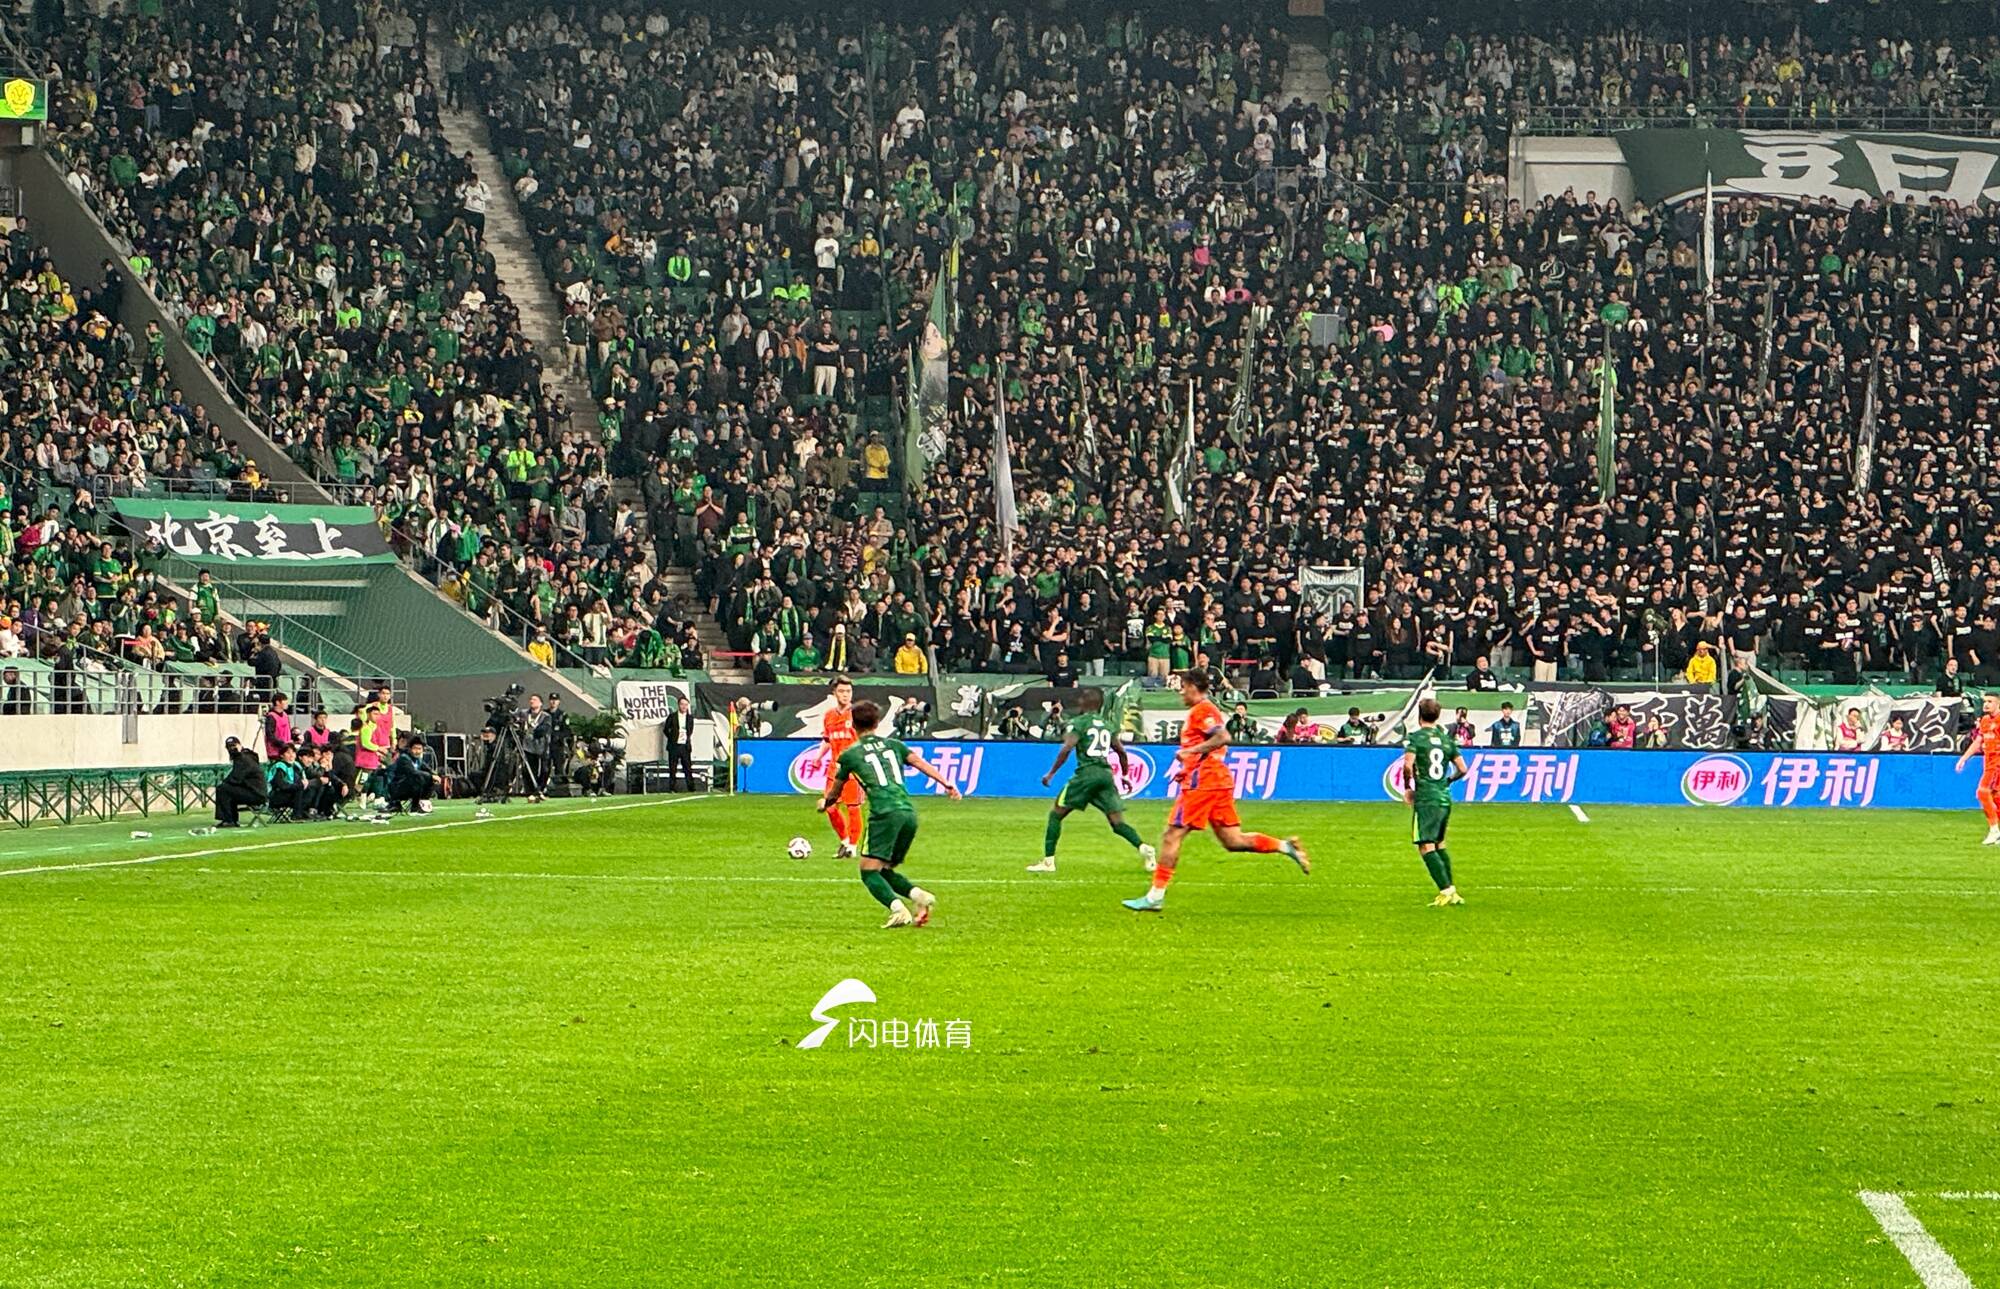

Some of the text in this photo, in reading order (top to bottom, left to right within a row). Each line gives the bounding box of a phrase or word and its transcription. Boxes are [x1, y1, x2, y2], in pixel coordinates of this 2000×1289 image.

[145, 509, 364, 561] 北京至上
[623, 697, 667, 709] NORTH
[639, 685, 665, 697] THE
[626, 708, 669, 720] STAND
[1086, 728, 1112, 757] 29
[864, 749, 903, 787] 11
[1428, 748, 1445, 780] 8
[1463, 752, 1580, 803] 伊利
[1692, 769, 1740, 792] 伊利
[1760, 756, 1880, 807] 伊利
